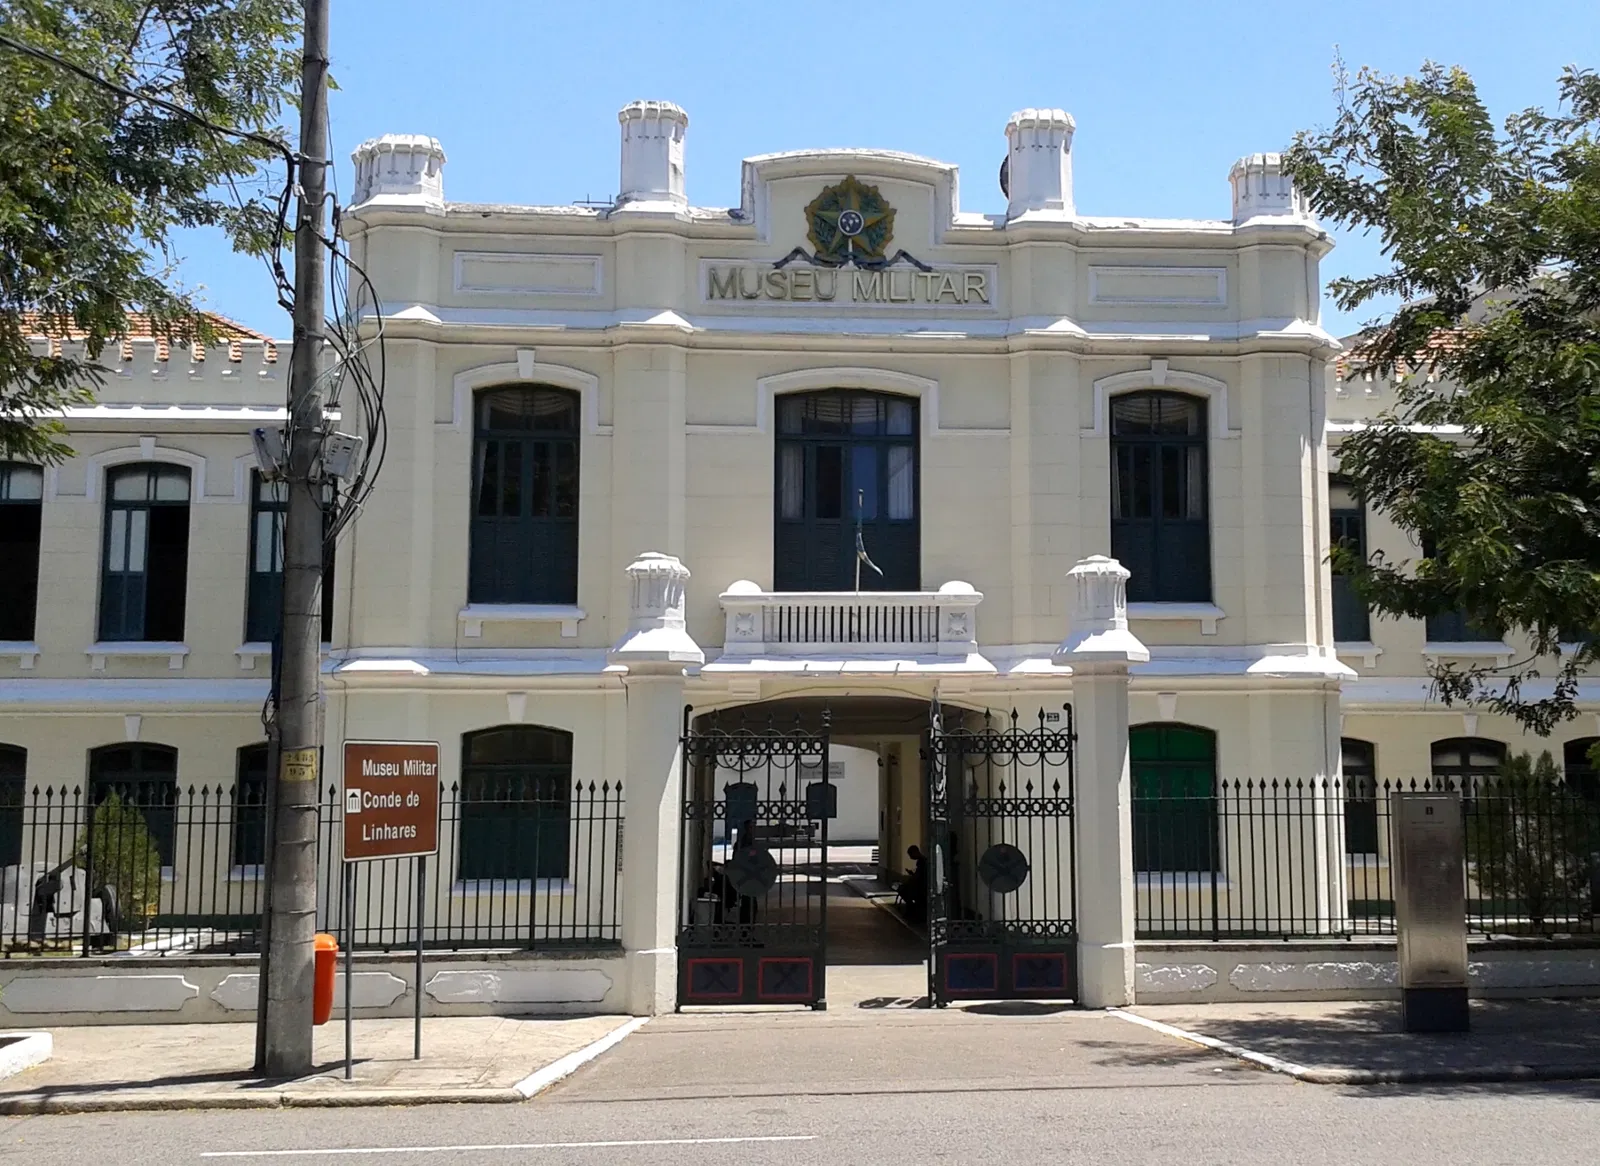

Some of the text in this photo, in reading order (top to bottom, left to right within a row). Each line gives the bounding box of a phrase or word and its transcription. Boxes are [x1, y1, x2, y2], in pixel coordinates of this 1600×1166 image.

[709, 267, 989, 303] MUSEU MILITAR
[362, 759, 437, 776] Museu Militar
[363, 790, 420, 808] Conde de
[362, 823, 417, 841] Linhares
